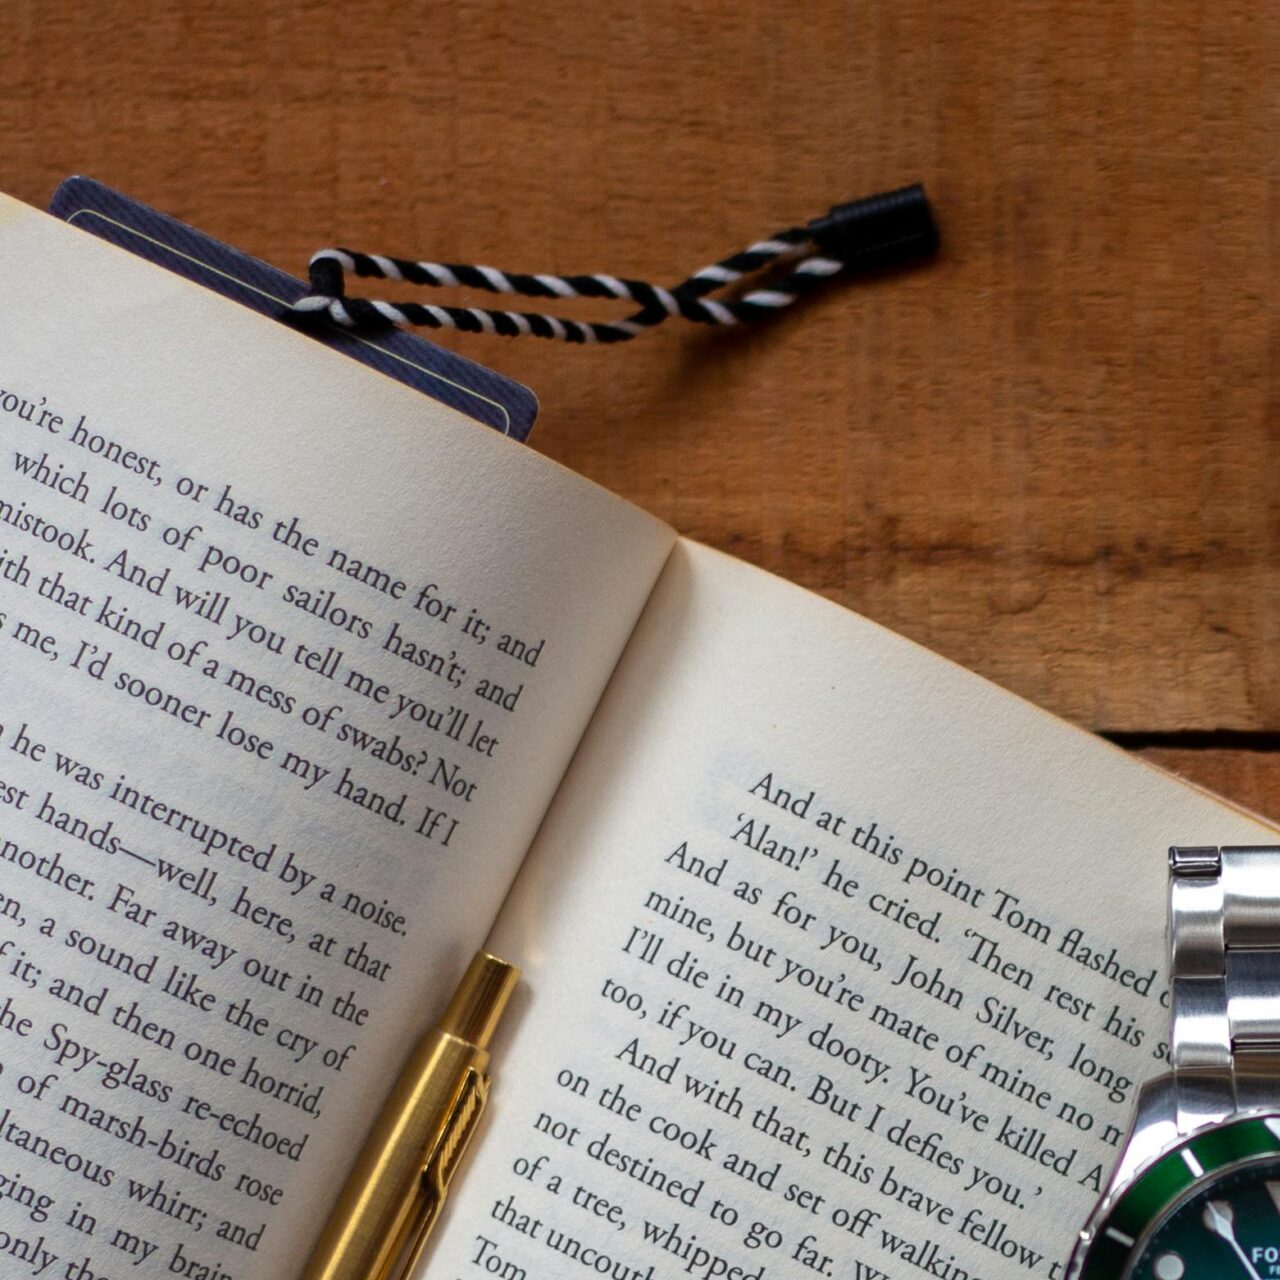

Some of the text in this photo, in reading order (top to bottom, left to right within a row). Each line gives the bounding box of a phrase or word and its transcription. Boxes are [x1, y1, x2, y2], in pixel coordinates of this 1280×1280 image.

[14, 451, 90, 504] which
[99, 485, 152, 532] lots
[162, 525, 204, 553] of
[197, 545, 274, 590] poor
[282, 584, 374, 640] sailors
[474, 679, 525, 713] and
[68, 415, 163, 487] honest,
[175, 477, 210, 503] or
[213, 484, 264, 530] has
[272, 517, 320, 557] the
[325, 549, 407, 600] name
[412, 583, 458, 624] for
[460, 608, 491, 645] it;
[496, 634, 546, 668] and
[9, 723, 407, 937] he was interrupted by a noise.
[11, 621, 59, 662] me,
[113, 672, 212, 730] sooner
[215, 710, 274, 760] lose
[279, 751, 332, 791] my
[332, 766, 408, 826] hand.
[414, 806, 448, 840] If
[440, 818, 460, 848] I
[106, 882, 158, 928] Far
[162, 921, 238, 970] away
[242, 958, 293, 992] out
[295, 974, 324, 1008] in
[331, 990, 370, 1027] the
[747, 772, 1158, 998] And at this point Tom flashed
[16, 1073, 284, 1206] of marsh-birds rose
